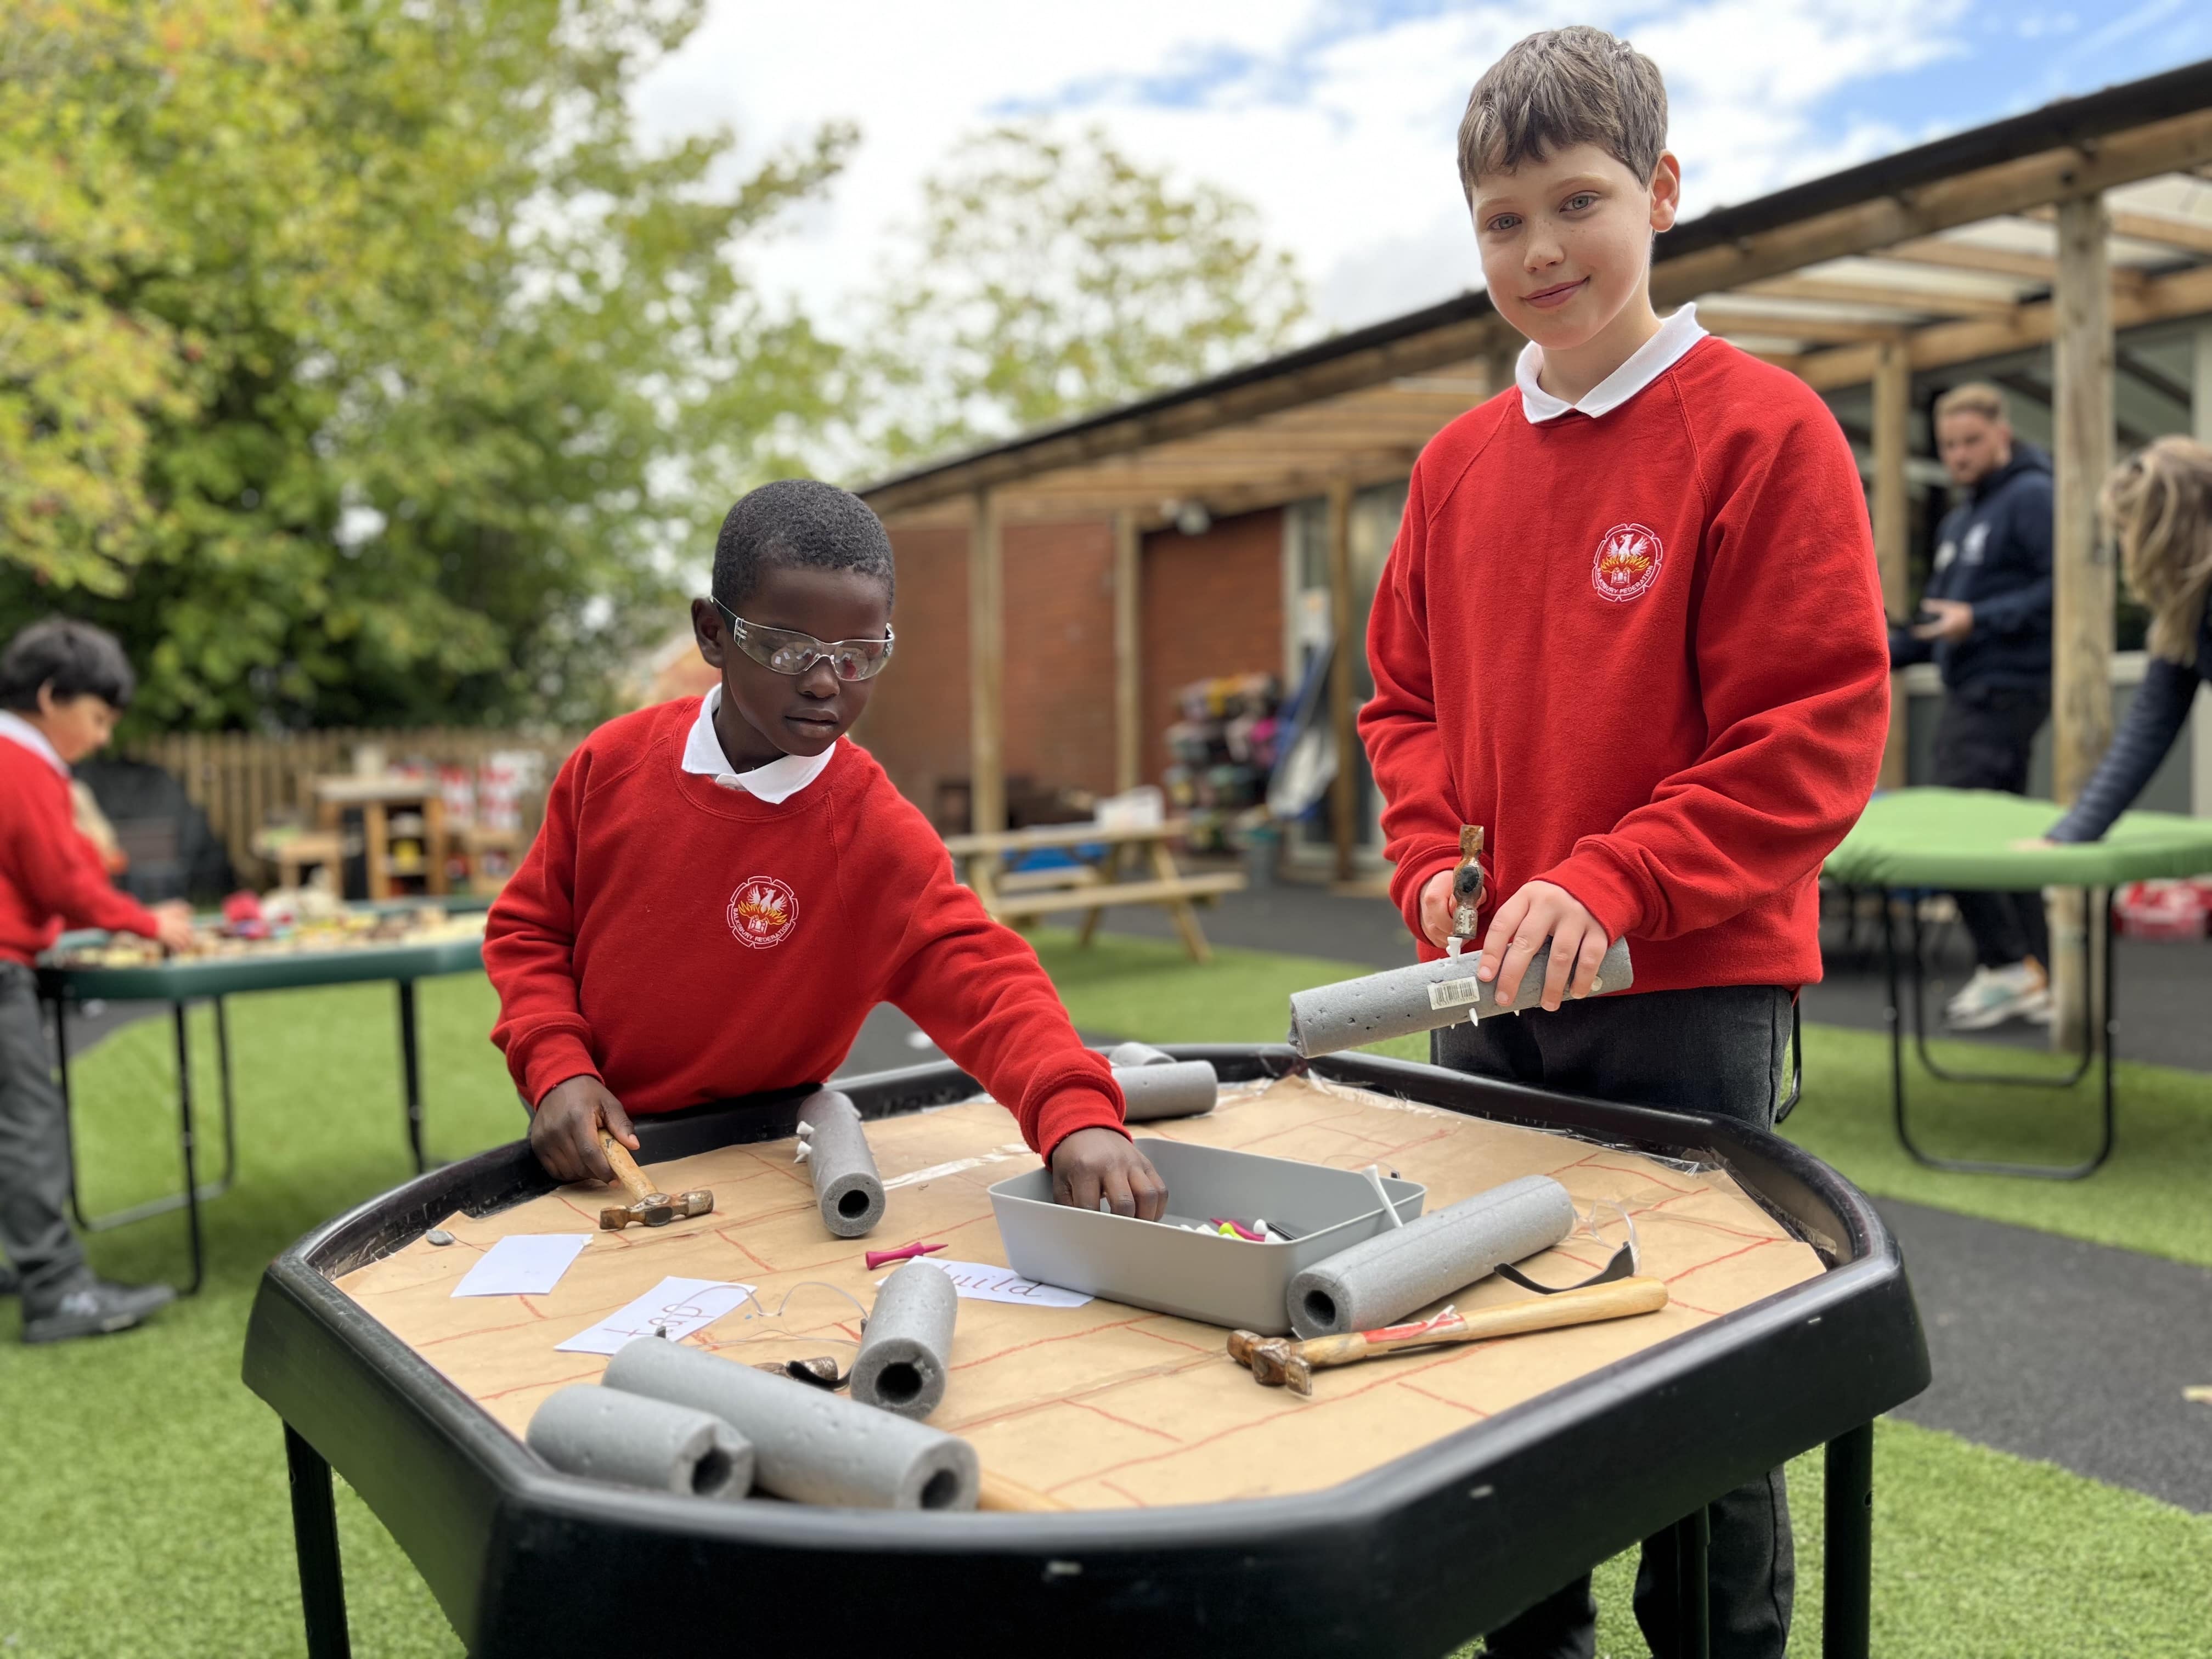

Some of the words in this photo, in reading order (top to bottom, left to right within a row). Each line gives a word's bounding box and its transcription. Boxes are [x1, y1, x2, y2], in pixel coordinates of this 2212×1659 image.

[1619, 565, 1654, 594] FEDERATION
[754, 922, 791, 942] FEDERATION
[941, 1263, 1042, 1296] uild
